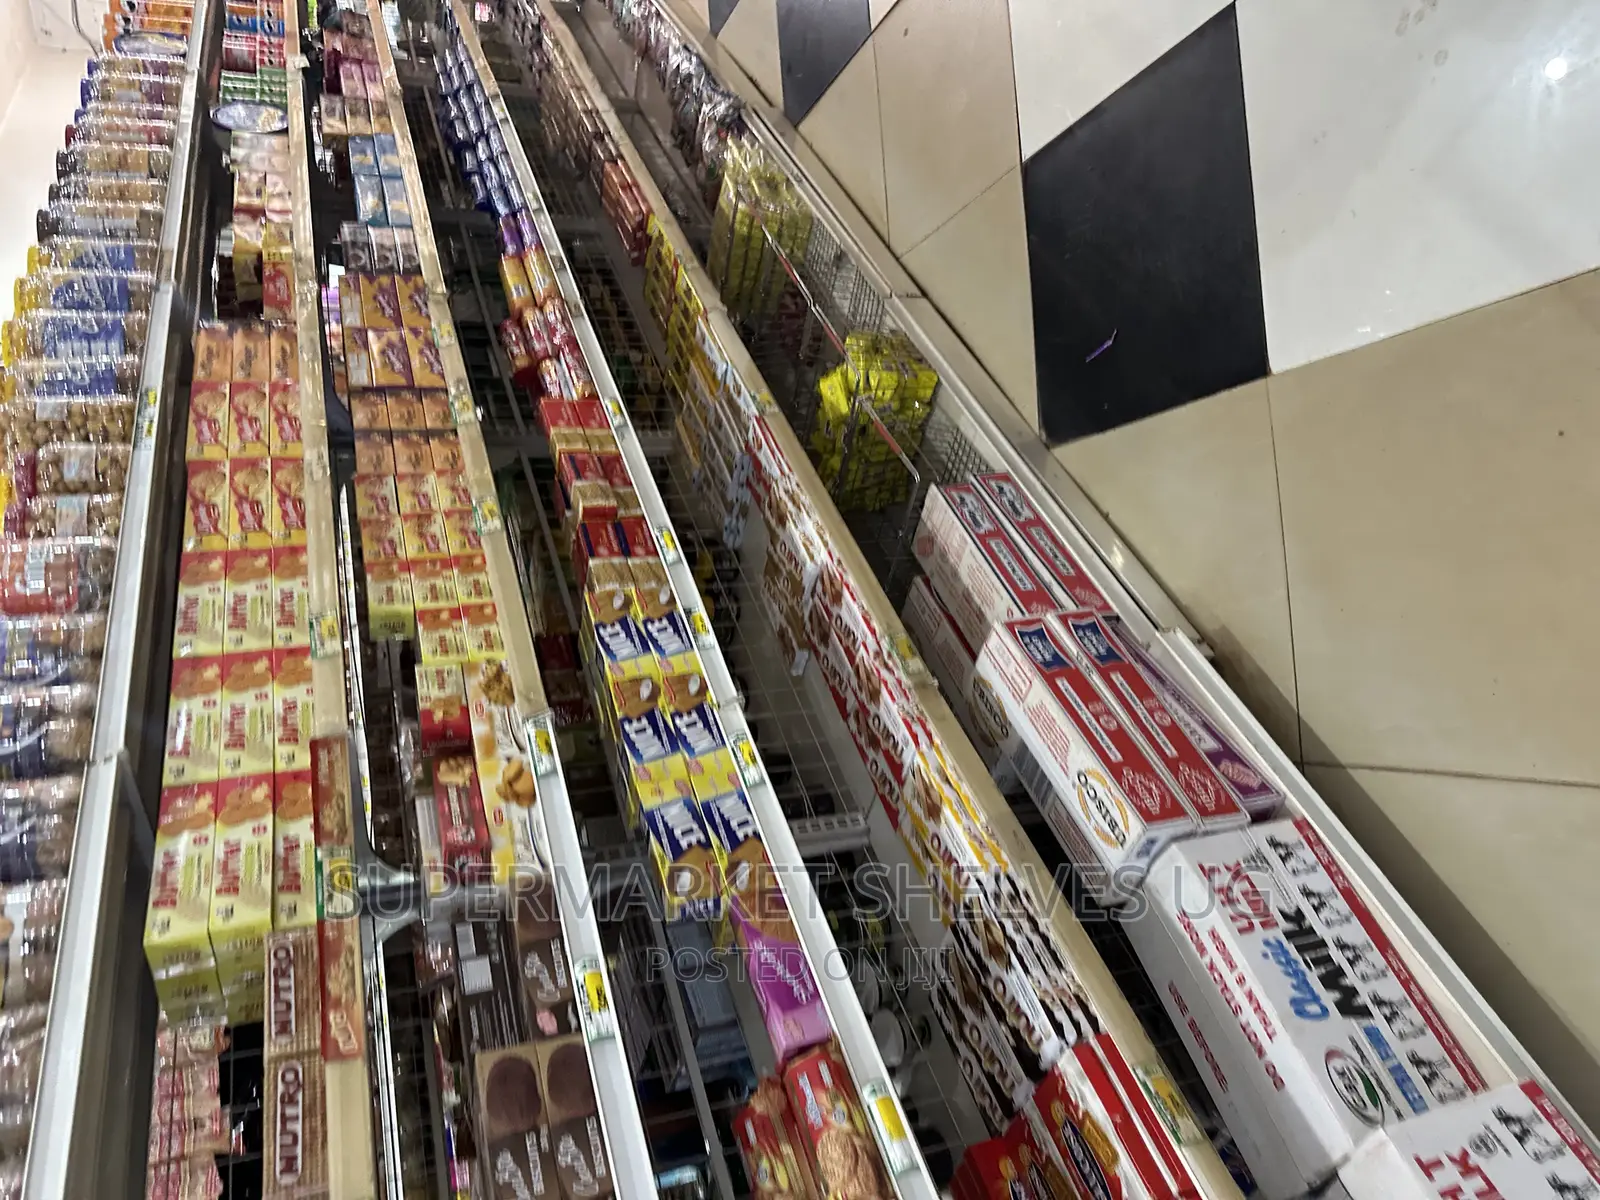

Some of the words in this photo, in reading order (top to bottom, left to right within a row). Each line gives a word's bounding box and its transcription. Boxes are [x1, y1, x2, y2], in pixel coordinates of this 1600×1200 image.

[597, 620, 637, 658] NICE
[645, 614, 685, 653] NICE
[832, 611, 861, 650] nutro
[621, 715, 665, 758] NICE
[673, 708, 716, 752] NICE
[868, 712, 905, 759] nutro
[657, 799, 707, 850] NICE
[713, 793, 758, 841] NICE
[1074, 769, 1127, 846] UBISCO
[1225, 862, 1280, 932] MILK
[1174, 908, 1210, 958] MORE
[1205, 925, 1238, 971] HIGH
[1202, 957, 1244, 1017] STACK
[1255, 931, 1331, 1029] Classic
[1272, 902, 1373, 1027] Milk
[272, 944, 292, 1036] NUTRO
[986, 975, 1044, 1051] nutro
[1164, 980, 1191, 1017] USE
[1239, 982, 1279, 1041] THAN
[1237, 1016, 1267, 1058] NOT
[1261, 1058, 1286, 1091] DO
[279, 1065, 300, 1175] NUTRO
